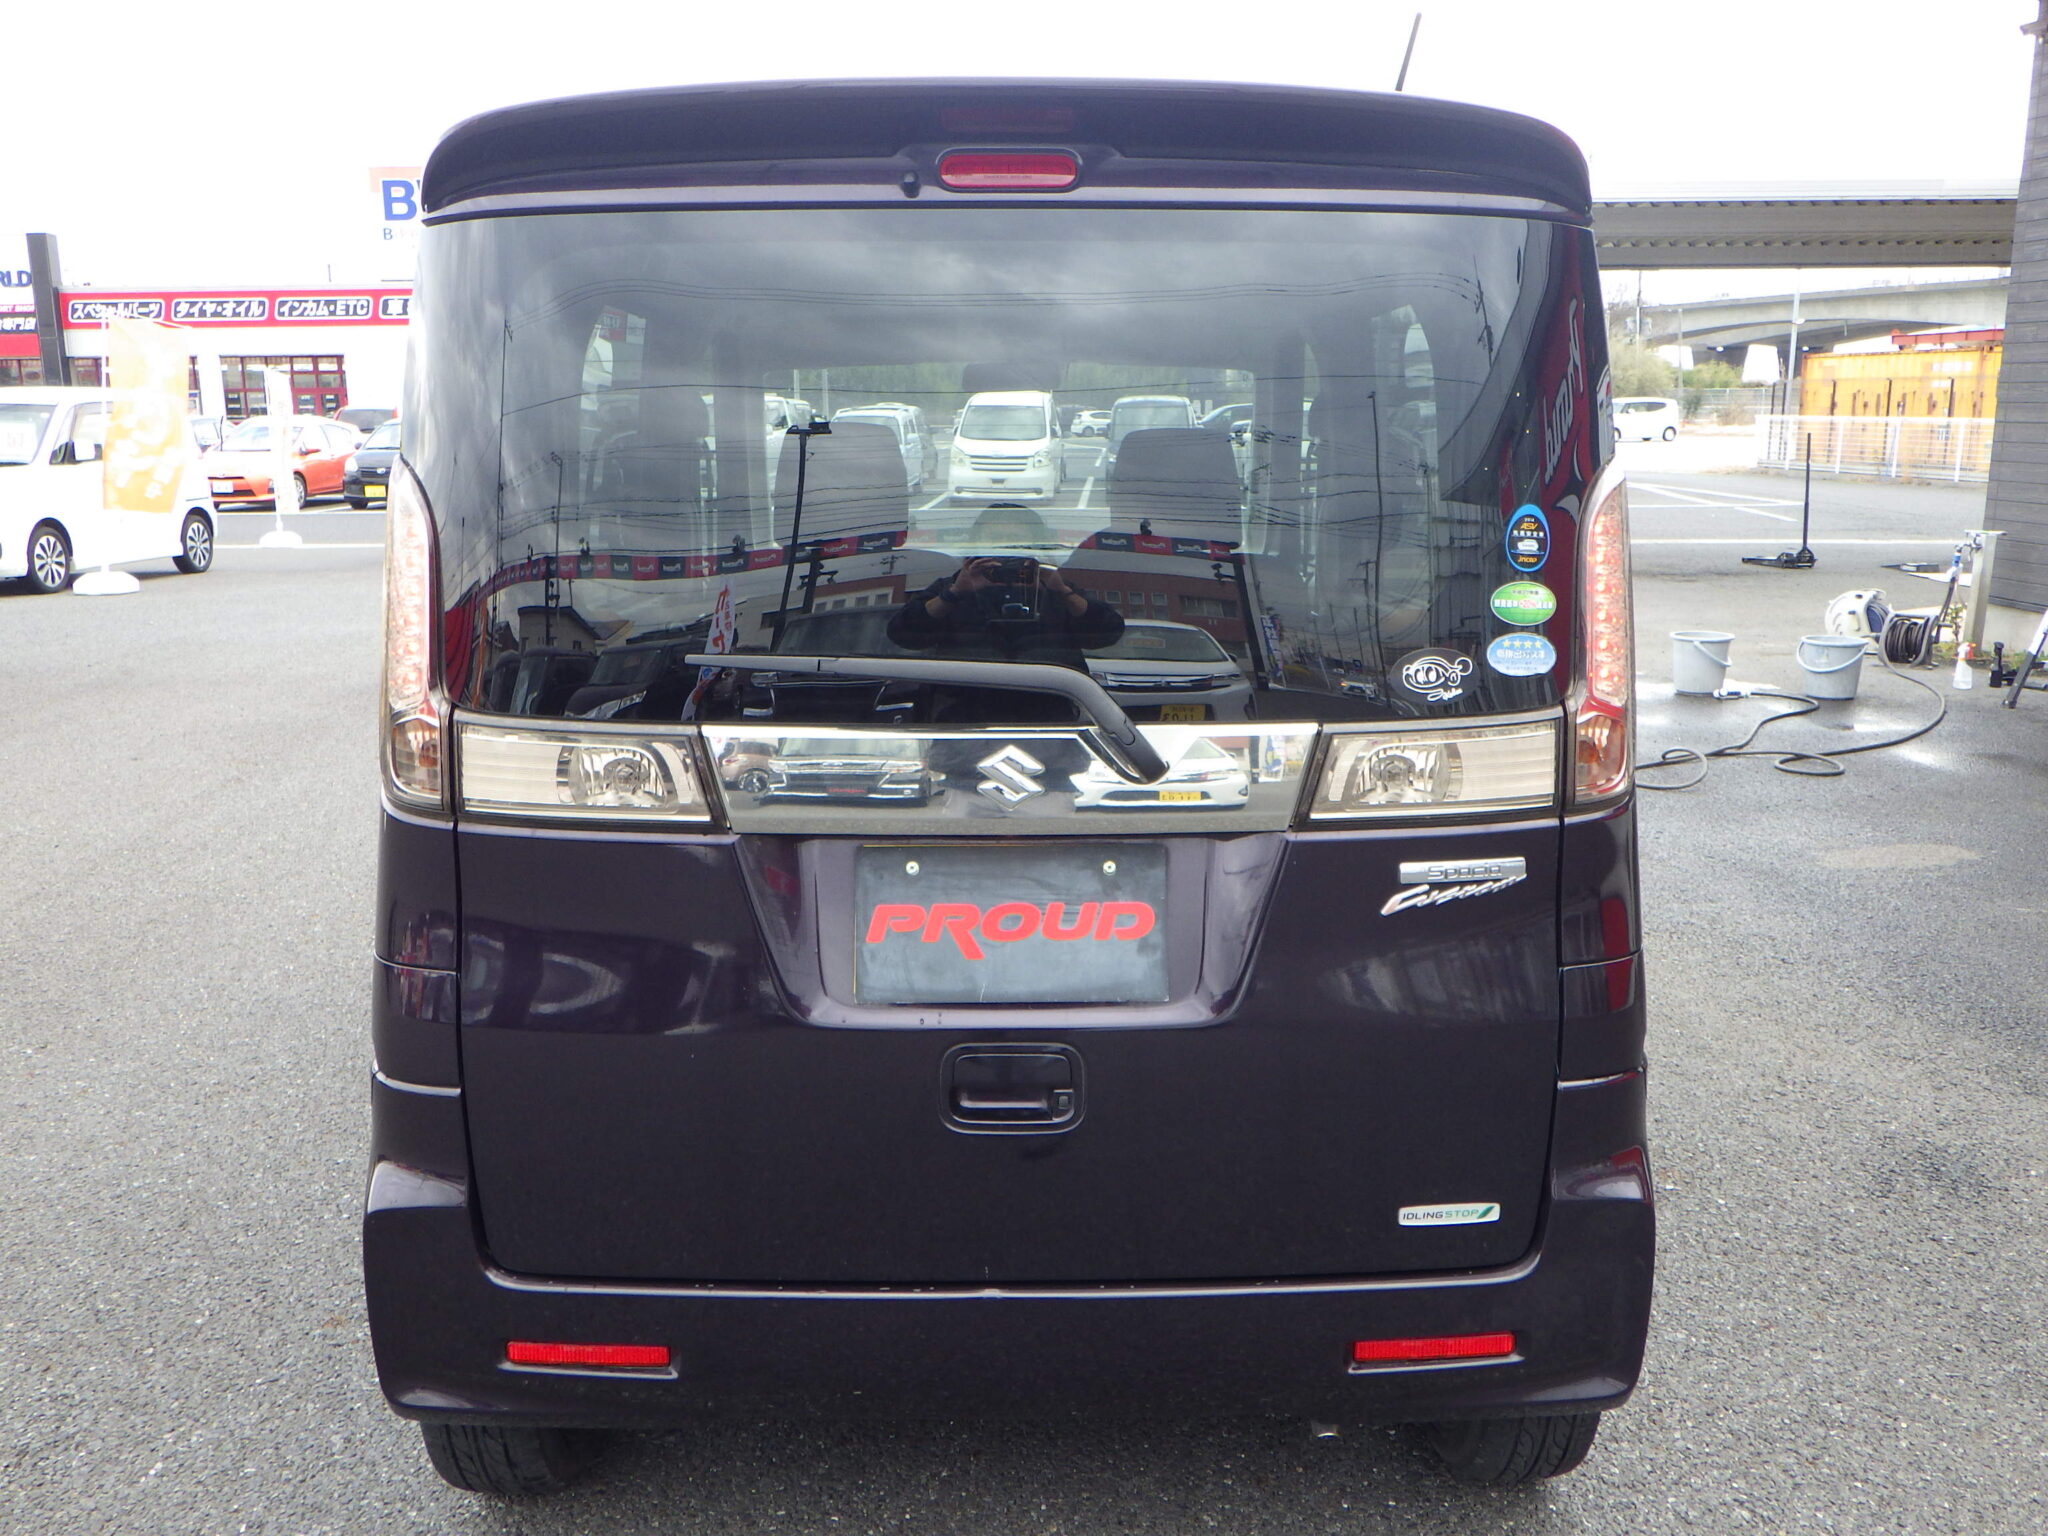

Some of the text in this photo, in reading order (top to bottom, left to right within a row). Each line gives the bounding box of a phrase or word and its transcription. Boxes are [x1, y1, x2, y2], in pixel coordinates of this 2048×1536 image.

[382, 180, 421, 221] B
[176, 300, 264, 318] タイヤ・オイル
[279, 300, 369, 317] インカム・ETC
[0, 316, 36, 331] 専門店
[1427, 865, 1502, 881] Spacia
[865, 901, 1156, 960] PROUD
